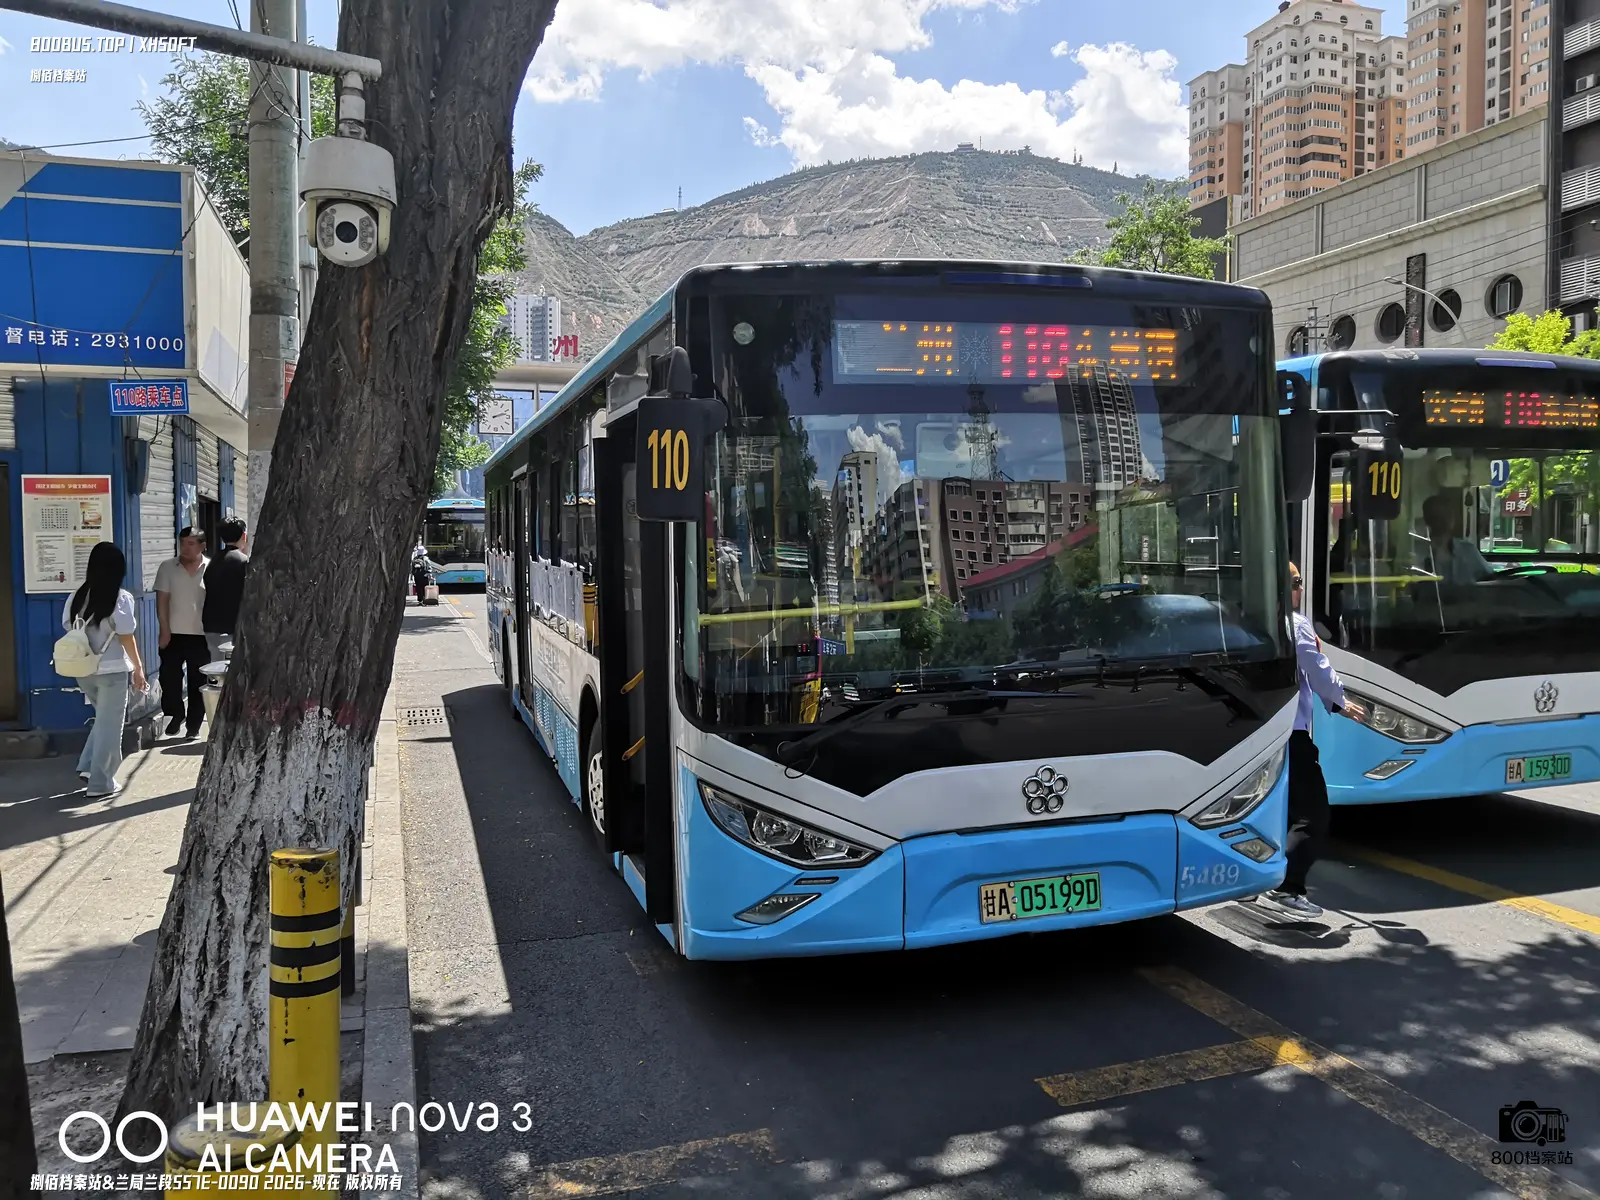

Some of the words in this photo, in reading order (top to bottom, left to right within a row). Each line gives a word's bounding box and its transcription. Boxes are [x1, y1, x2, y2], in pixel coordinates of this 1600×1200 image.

[553, 335, 579, 357] 州
[1000, 325, 1069, 379] 110
[115, 386, 184, 407] 110路乘车点
[1504, 392, 1541, 426] 110
[648, 429, 690, 491] 110
[1368, 461, 1400, 500] 110
[1181, 863, 1240, 889] 5489
